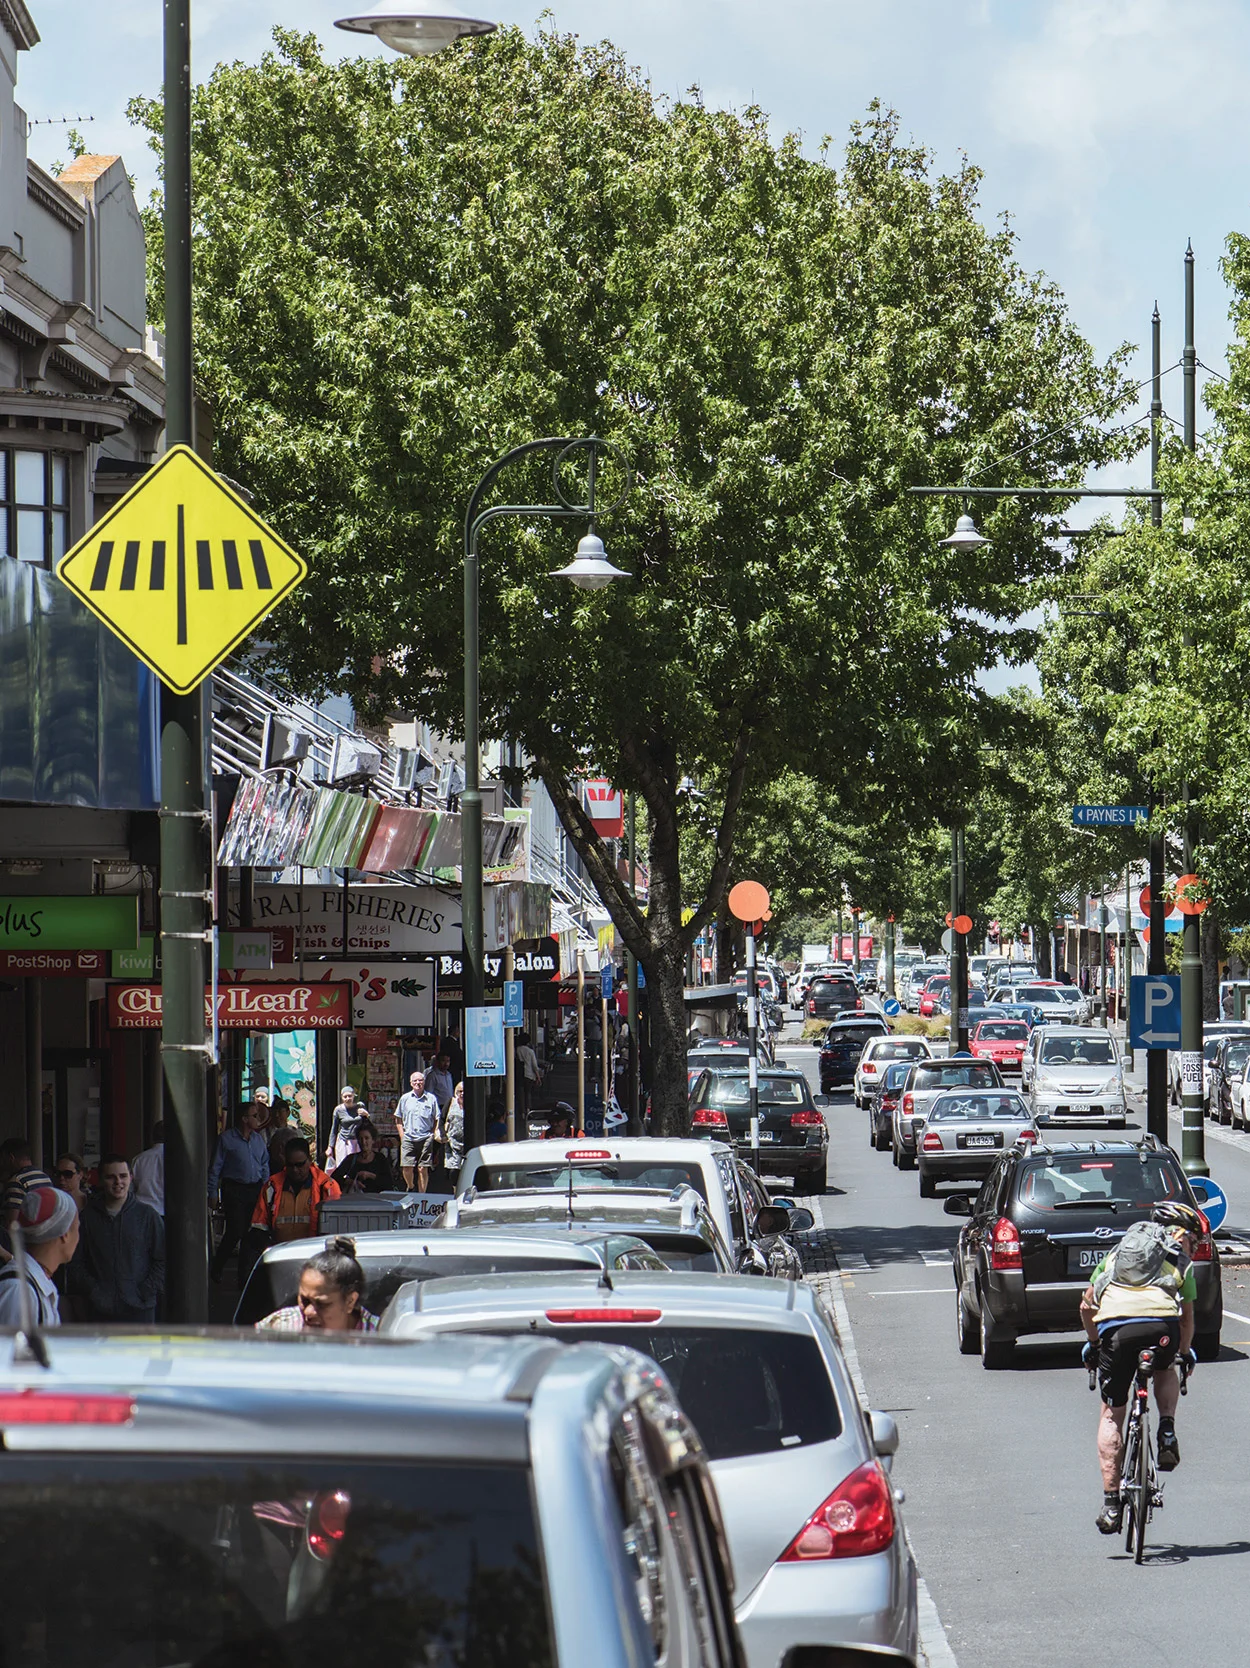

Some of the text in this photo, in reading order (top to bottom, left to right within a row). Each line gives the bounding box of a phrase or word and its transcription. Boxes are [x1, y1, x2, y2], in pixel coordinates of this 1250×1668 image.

[1086, 809, 1126, 822] PAYNES
[0, 903, 43, 938] lus
[319, 890, 446, 935] FISHERIES
[237, 944, 267, 957] ATM
[348, 937, 391, 950] Chips
[7, 954, 72, 971] PostShop
[440, 955, 502, 977] Bety
[509, 984, 518, 1001] P
[117, 988, 313, 1019] Cuy Leaf
[509, 1004, 518, 1016] 30
[1144, 982, 1174, 1025] P
[116, 1016, 163, 1028] India
[265, 1018, 279, 1028] Ph
[280, 1015, 306, 1027] 636
[310, 1015, 344, 1026] 9666
[475, 1041, 495, 1059] 30
[1182, 1063, 1203, 1073] FOSS
[1081, 1251, 1105, 1265] DAB
